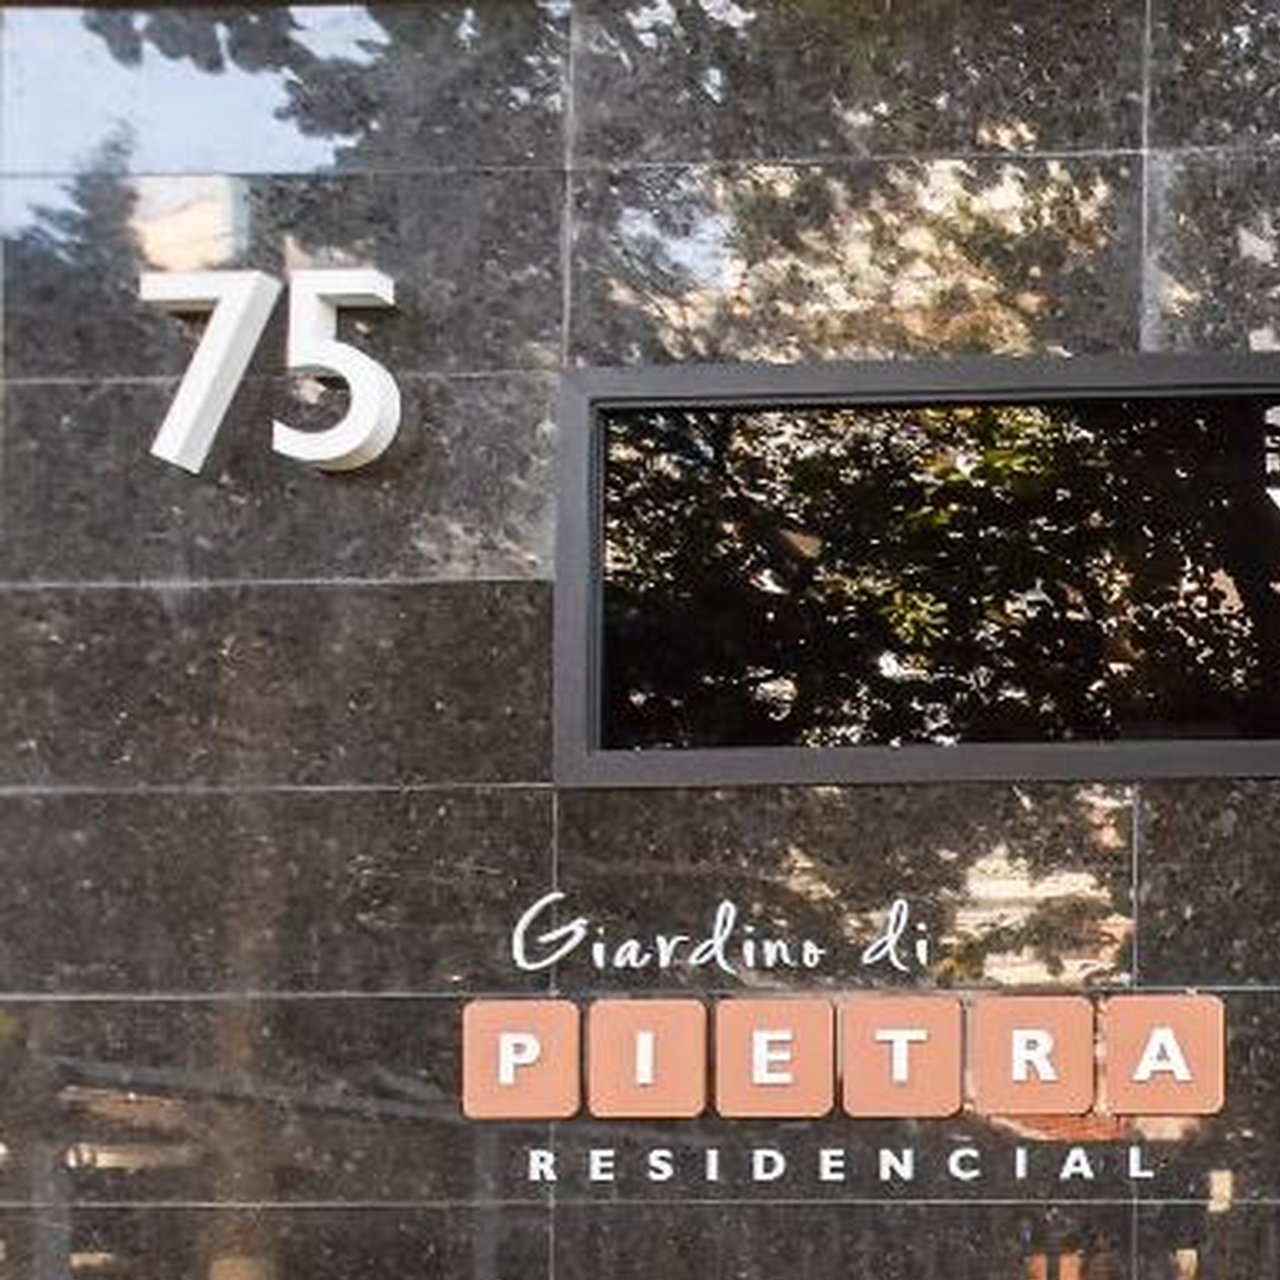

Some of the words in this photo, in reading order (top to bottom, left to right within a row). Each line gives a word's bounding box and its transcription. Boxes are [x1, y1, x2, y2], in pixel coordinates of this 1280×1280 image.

[139, 267, 402, 474] 75
[511, 891, 827, 974] Giardino
[860, 898, 930, 972] di
[497, 1027, 1192, 1084] PIETRA
[528, 1146, 1156, 1182] RESIDENCIAL
